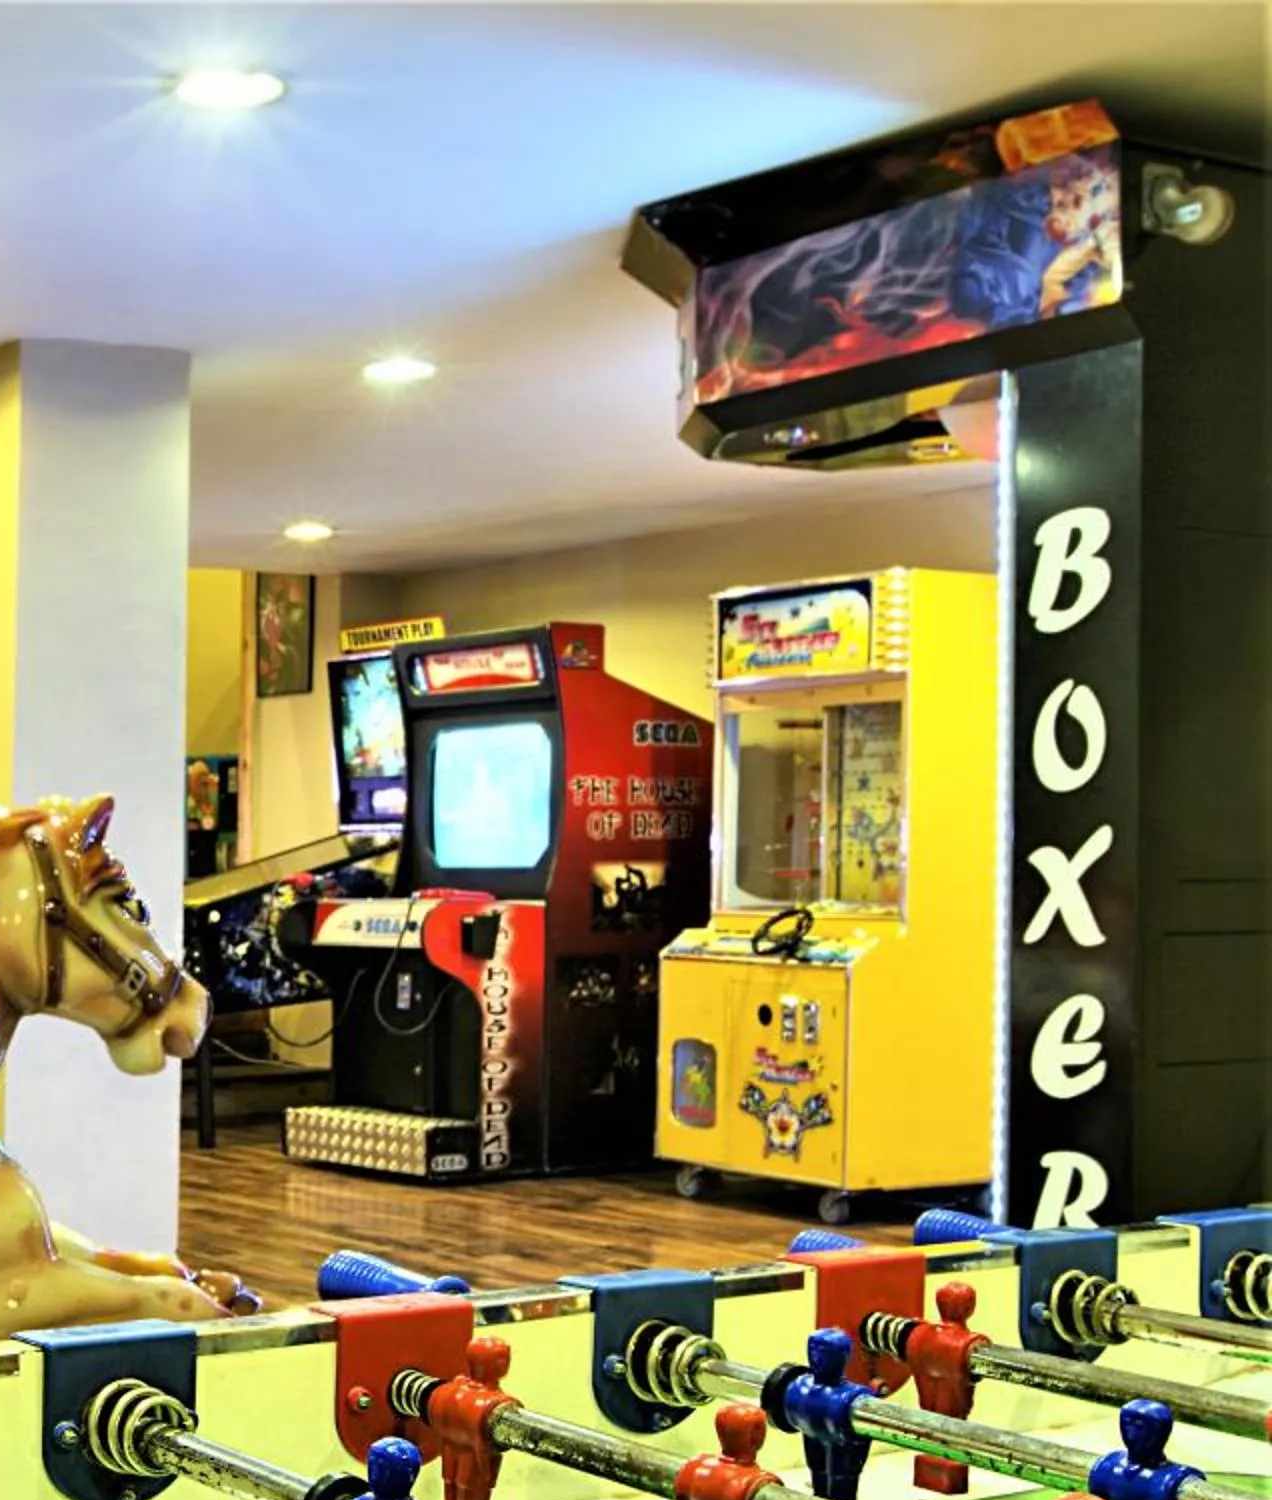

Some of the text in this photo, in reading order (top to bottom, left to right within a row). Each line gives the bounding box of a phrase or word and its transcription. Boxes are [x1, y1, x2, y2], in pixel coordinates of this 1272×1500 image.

[345, 621, 434, 647] TOURNAMENT PLAY
[633, 720, 701, 747] SEGA
[569, 774, 698, 806] THE HOUSE
[587, 810, 694, 840] OF DEAD
[366, 917, 402, 934] SEGA
